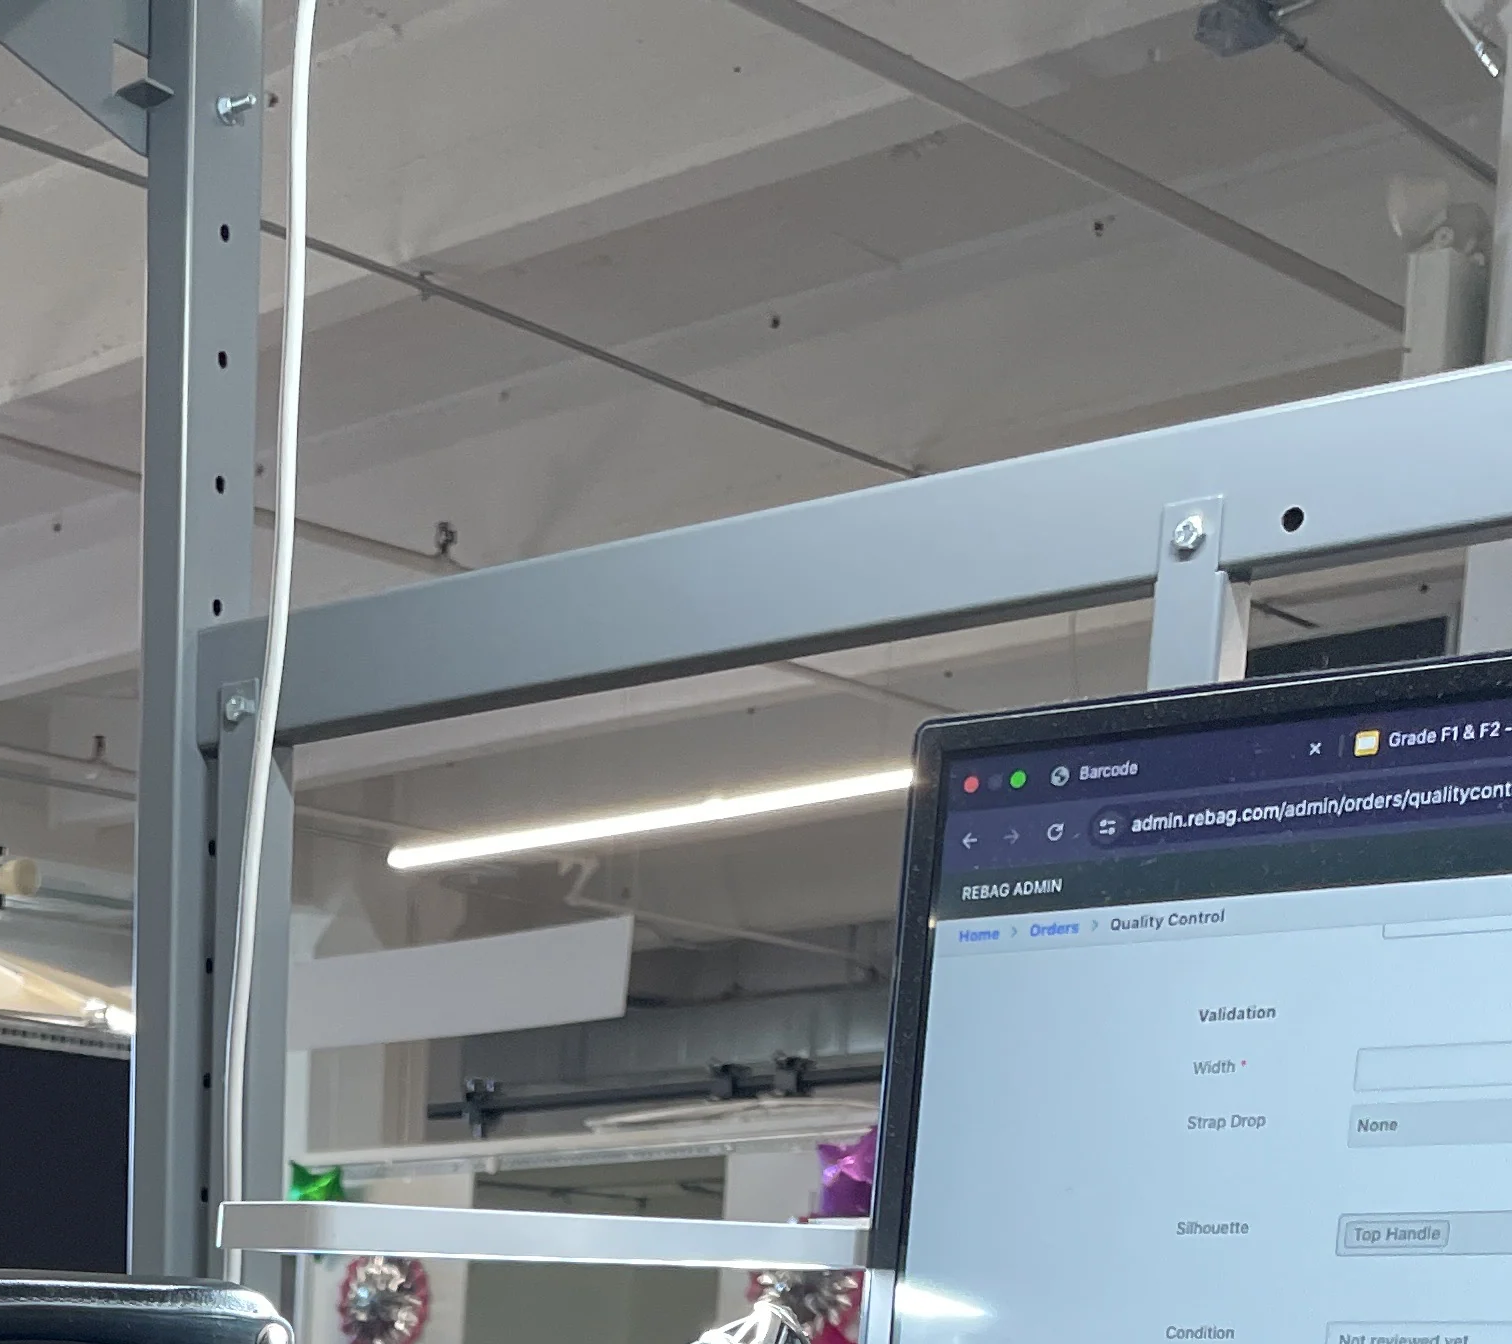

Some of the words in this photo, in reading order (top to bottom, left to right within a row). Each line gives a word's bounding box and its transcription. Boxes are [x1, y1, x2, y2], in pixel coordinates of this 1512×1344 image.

[1388, 728, 1437, 748] Grade
[1441, 725, 1459, 742] F1
[1463, 724, 1475, 740] &
[1479, 721, 1501, 738] F2
[1079, 760, 1138, 780] Barcode
[1131, 781, 1512, 833] admin.rebag.com/admin/orders/qualitycont
[962, 882, 1009, 900] REBAG
[1012, 878, 1063, 896] ADMIN
[1110, 914, 1164, 931] Quality
[1168, 908, 1226, 926] Control
[958, 929, 1000, 943] Home
[1029, 922, 1079, 938] Orders
[1198, 1005, 1277, 1022] Validation
[1193, 1058, 1236, 1075] Width
[1187, 1115, 1227, 1131] Strap
[1230, 1114, 1266, 1129] Drop
[1357, 1118, 1398, 1133] None
[1176, 1221, 1249, 1236] Silhouette
[1354, 1227, 1381, 1243] Top
[1386, 1225, 1441, 1241] Handle
[1165, 1325, 1235, 1340] Condition
